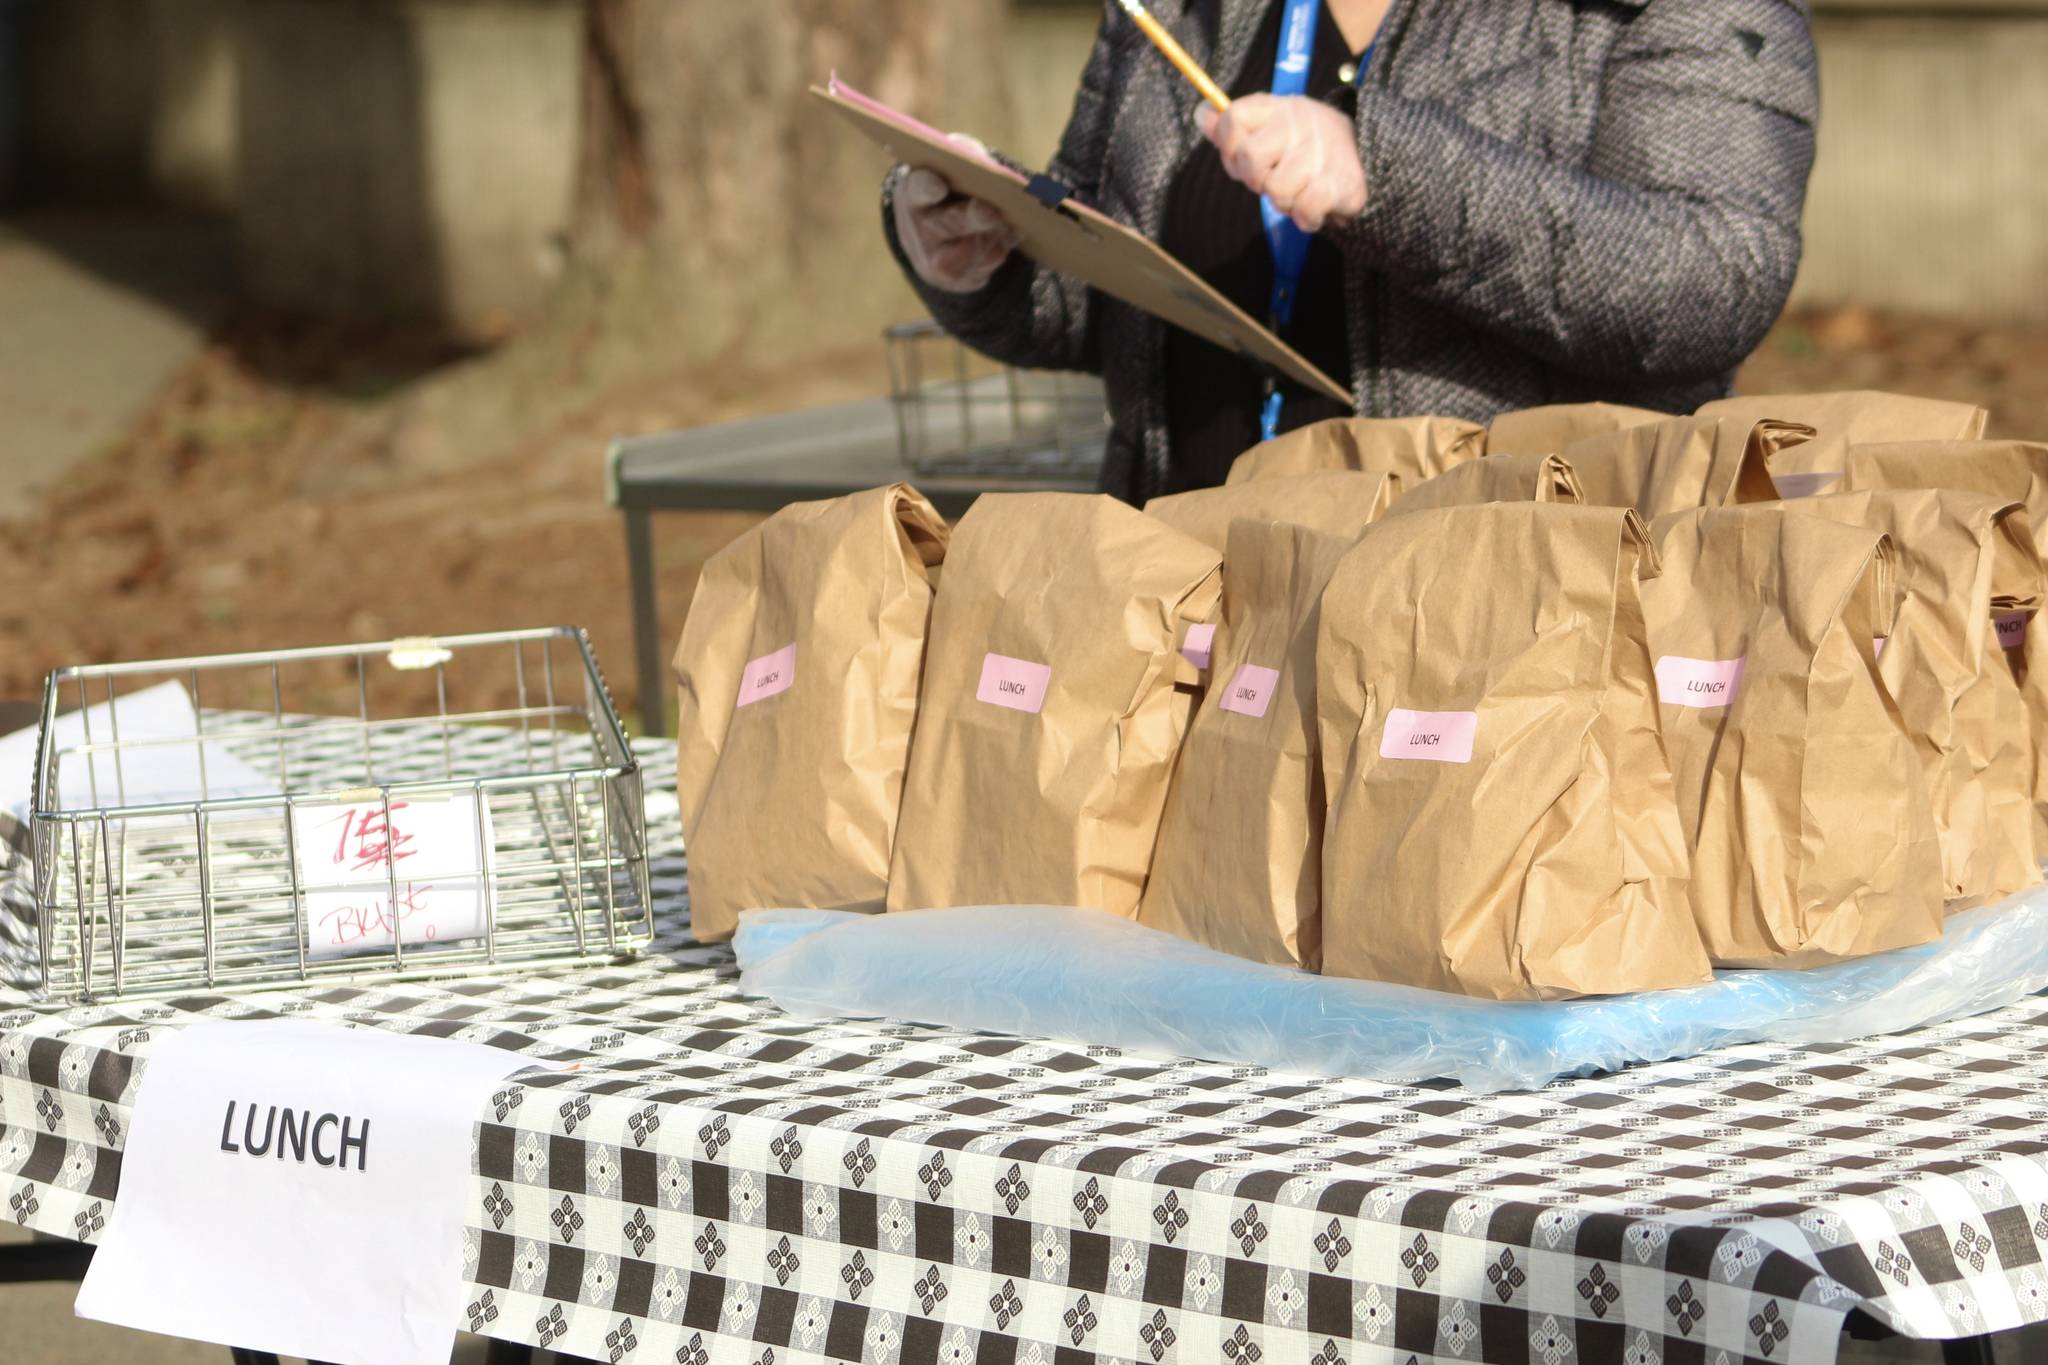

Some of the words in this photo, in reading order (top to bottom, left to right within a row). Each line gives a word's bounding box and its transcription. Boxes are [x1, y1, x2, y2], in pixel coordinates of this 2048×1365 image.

[1995, 619, 2022, 634] NCH
[756, 670, 779, 688] LUNCH
[1687, 680, 1726, 692] LUNCH
[999, 680, 1025, 695] LUNCH
[1236, 688, 1257, 700] LUNCH
[1409, 734, 1440, 745] LUNCH
[221, 1100, 370, 1171] LUNCH
